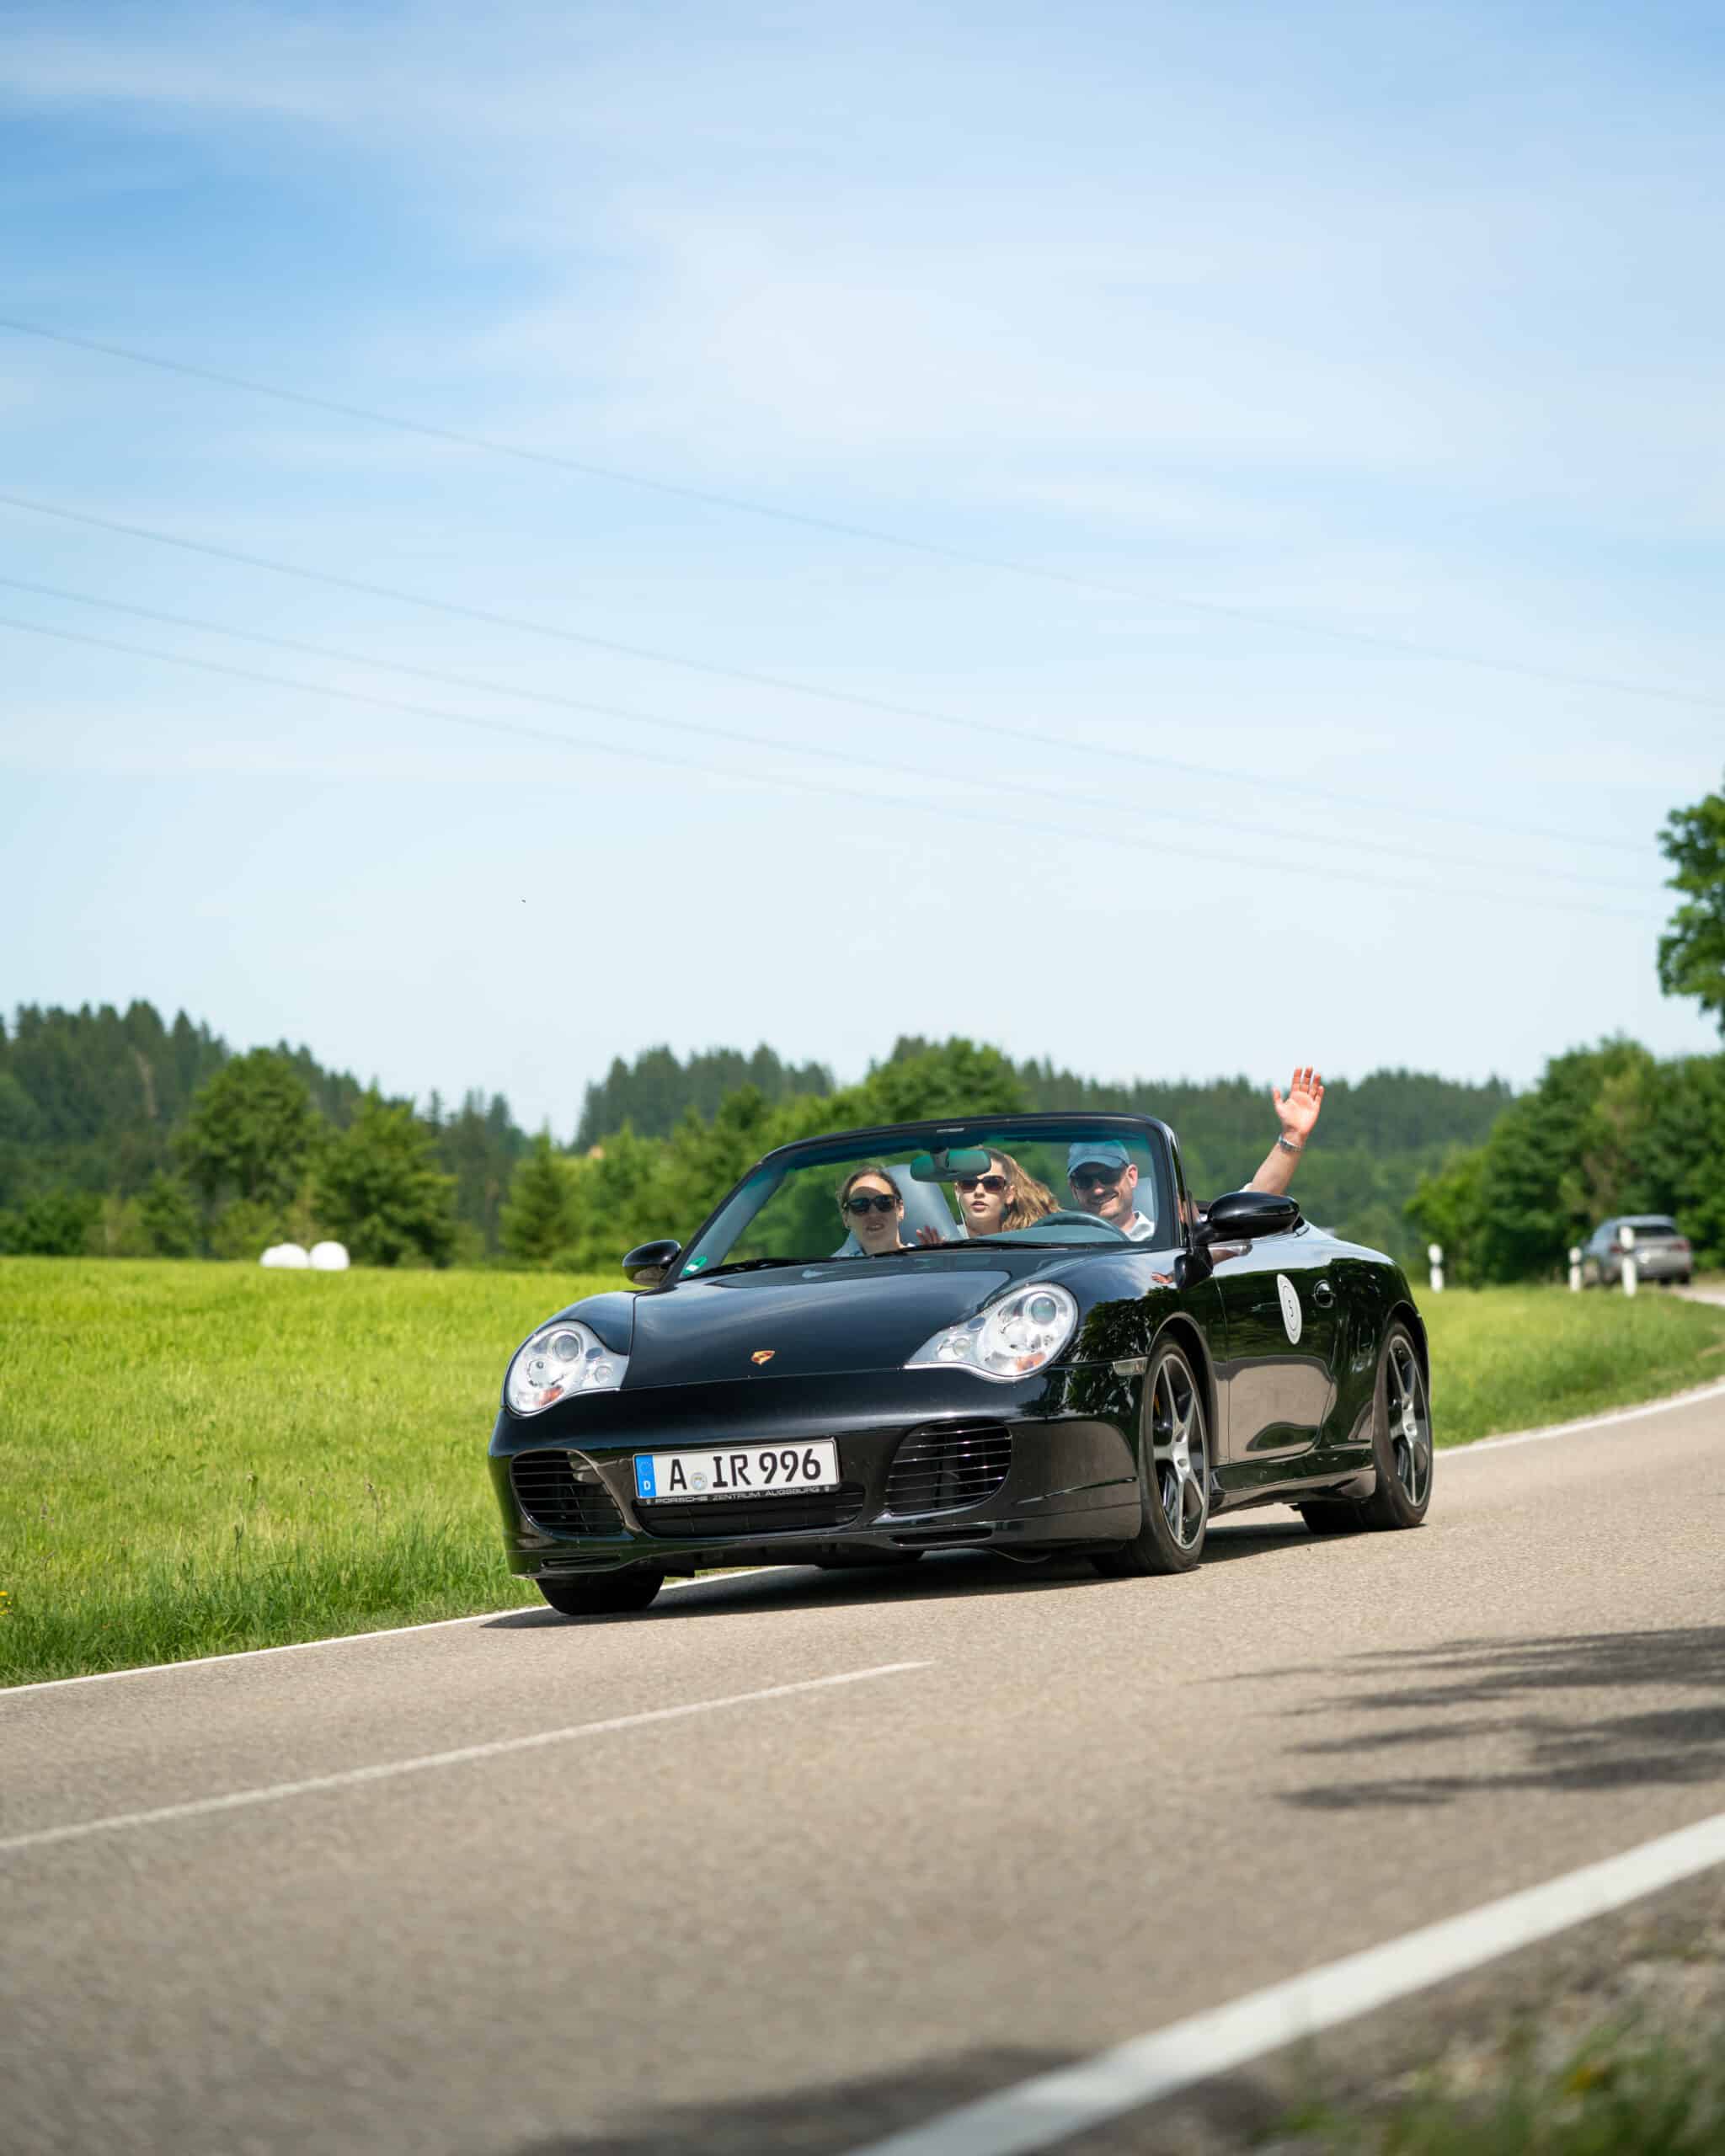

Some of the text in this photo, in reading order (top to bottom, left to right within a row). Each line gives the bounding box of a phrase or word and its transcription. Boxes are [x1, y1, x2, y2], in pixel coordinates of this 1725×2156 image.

[670, 1448, 821, 1492] A IR 996
[643, 1481, 651, 1491] D
[654, 1486, 821, 1504] PORSCHE ZENTRUM AUGSBURG
